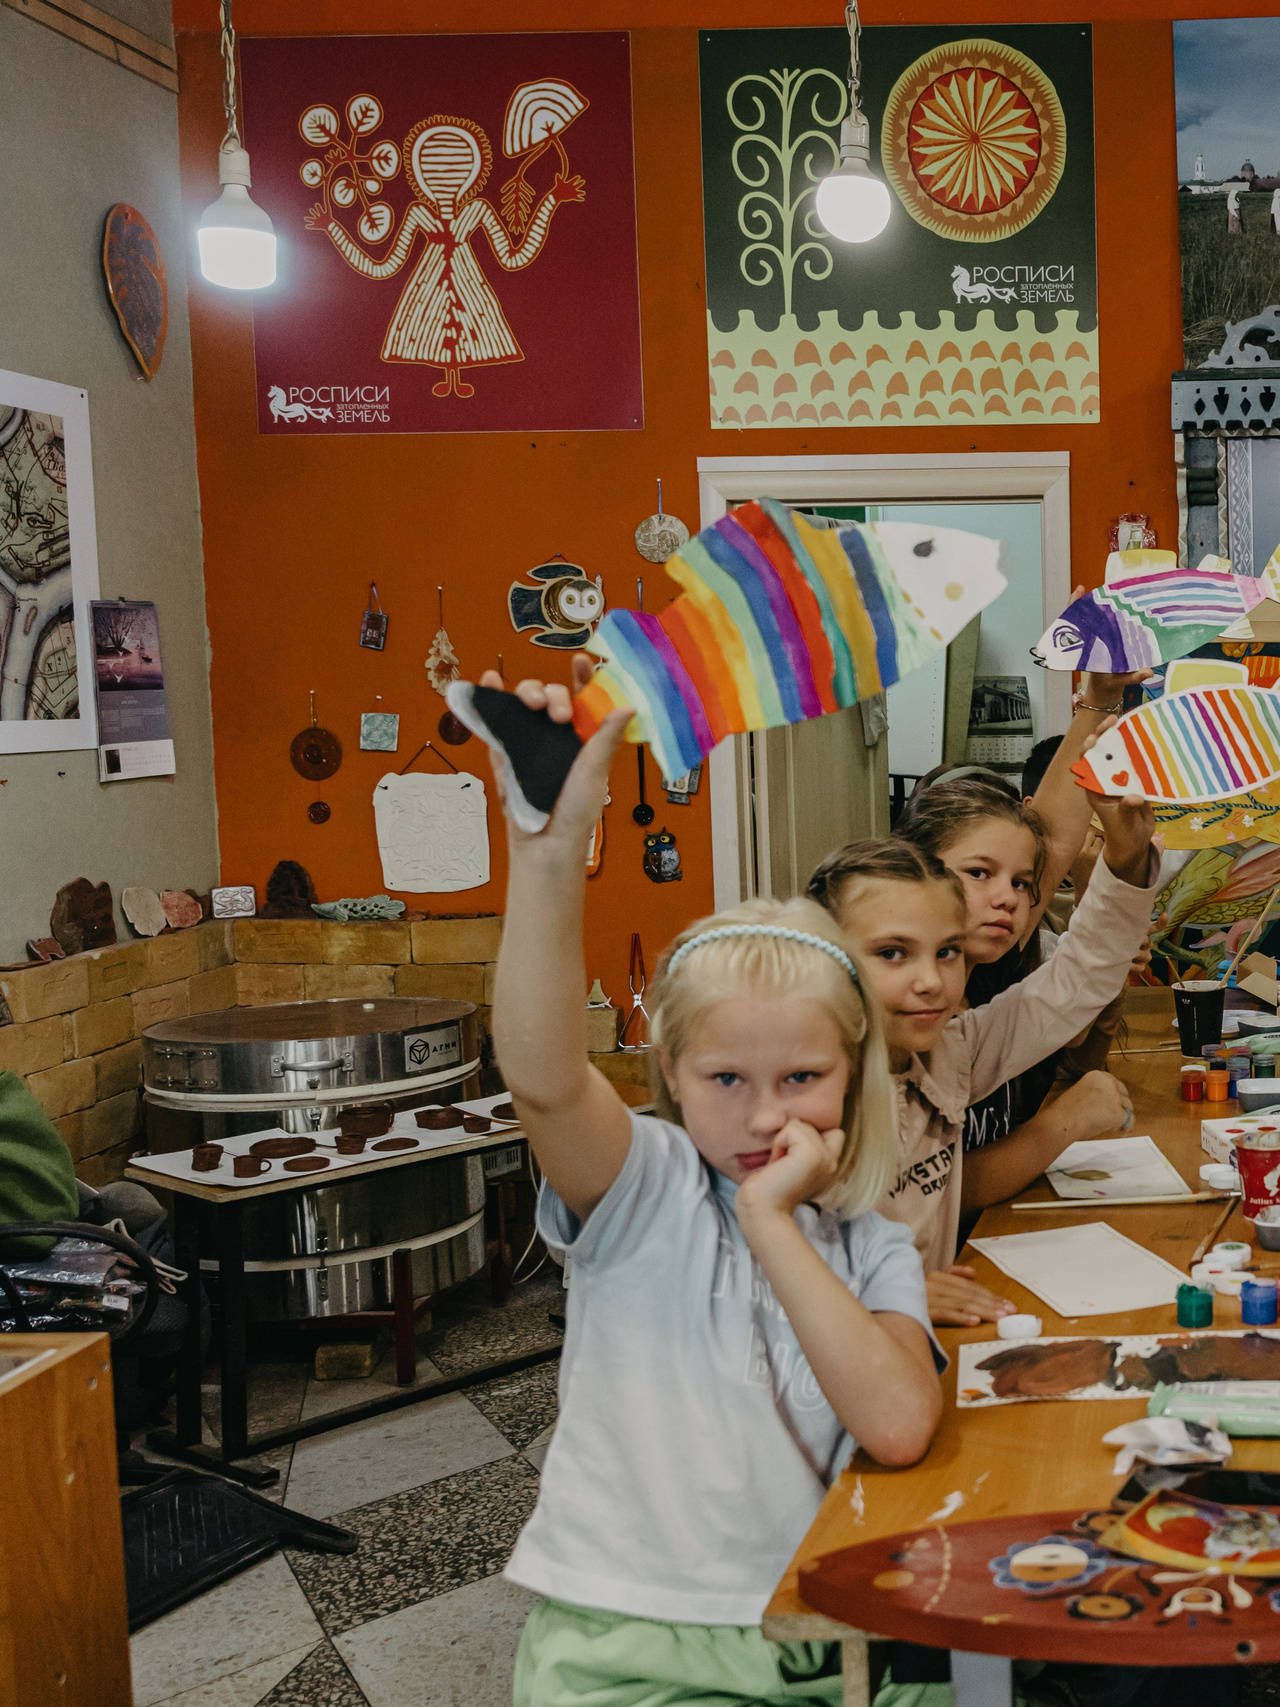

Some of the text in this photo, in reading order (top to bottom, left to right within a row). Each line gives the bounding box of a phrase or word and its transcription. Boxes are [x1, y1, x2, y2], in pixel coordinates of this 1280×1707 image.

[973, 265, 1075, 283] РОСПИСИ
[1020, 290, 1075, 303] ЗЕМЕЛЬ
[289, 385, 390, 403] РОСПИСИ
[336, 410, 391, 423] ЗЕМЕЛЬ
[432, 1041, 457, 1053] АГНИ
[1249, 1196, 1273, 1205] Julius
